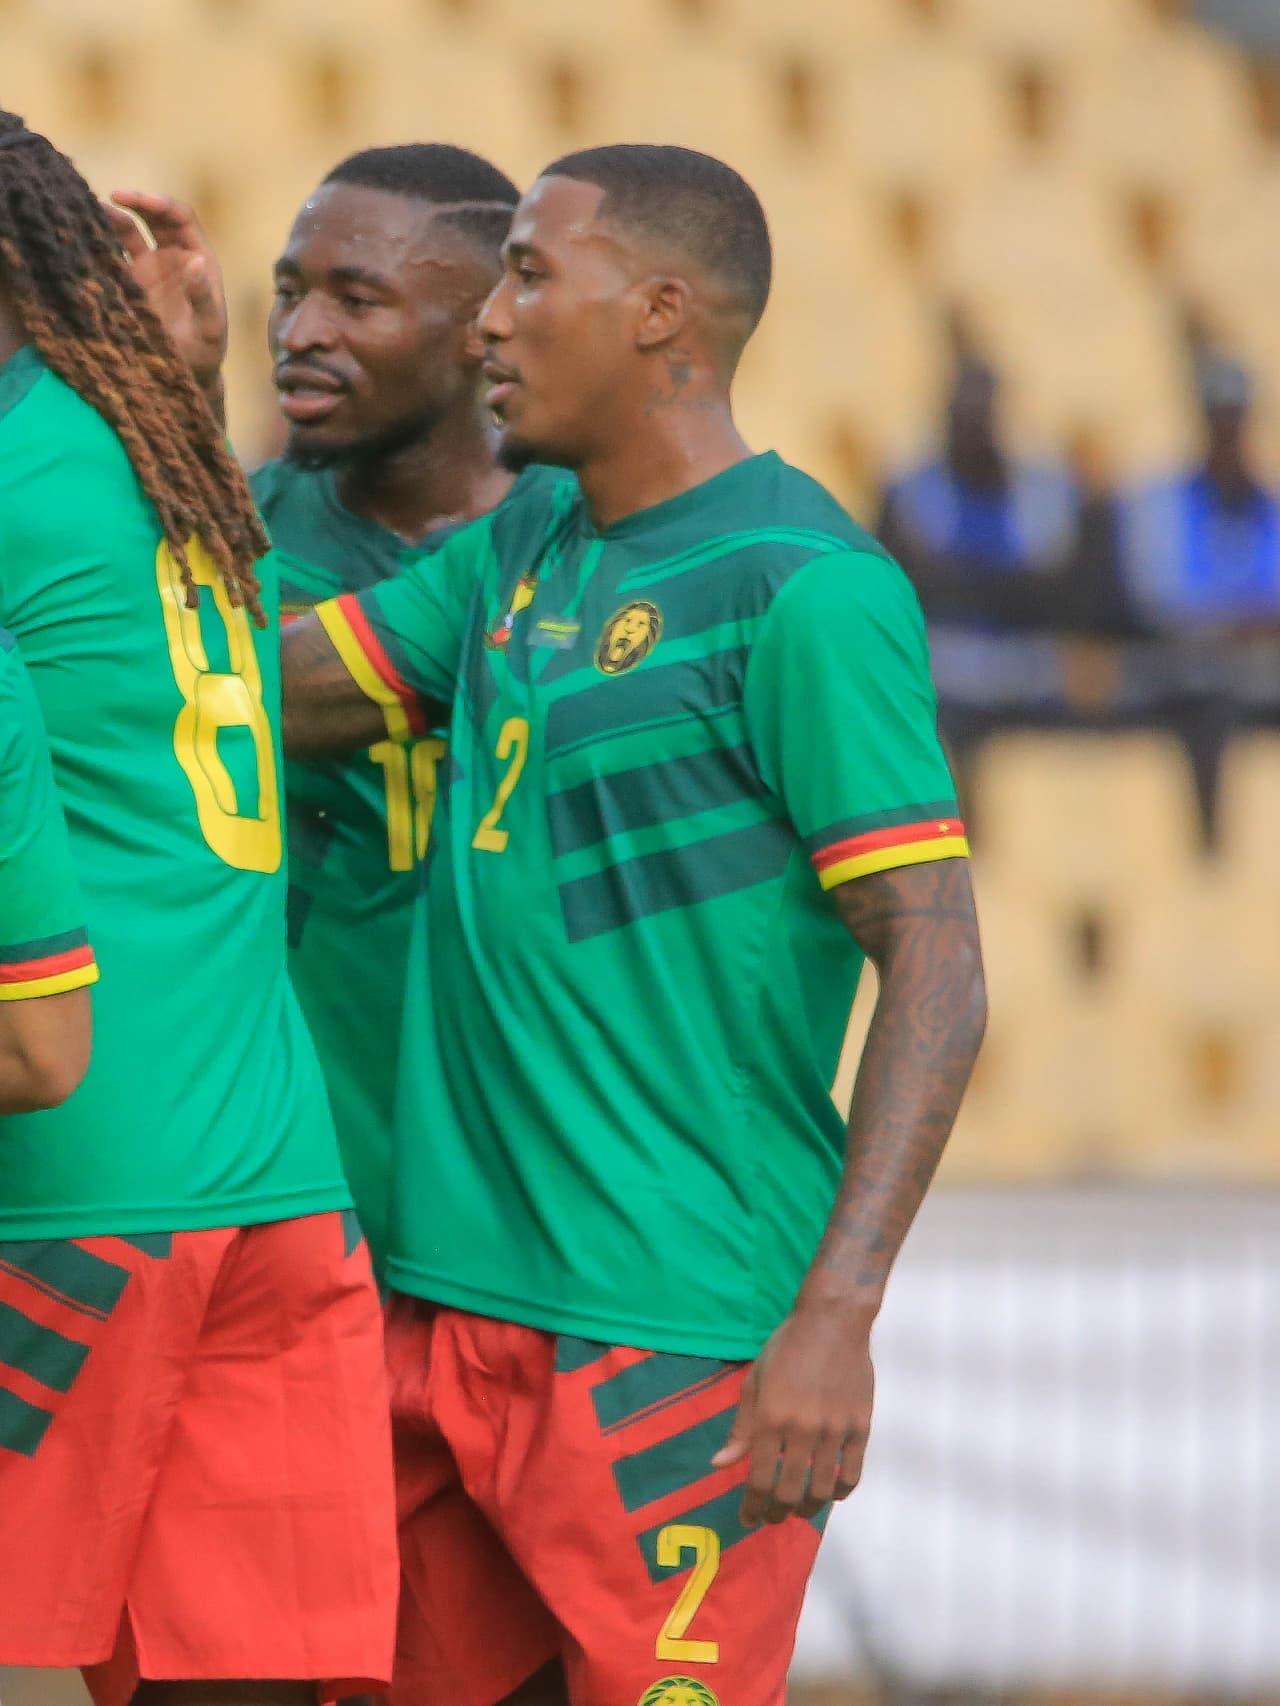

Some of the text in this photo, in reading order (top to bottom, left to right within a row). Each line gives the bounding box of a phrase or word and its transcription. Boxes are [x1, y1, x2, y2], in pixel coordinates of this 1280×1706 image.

[155, 532, 282, 874] 8
[471, 717, 529, 853] 2
[656, 1524, 720, 1664] 2
